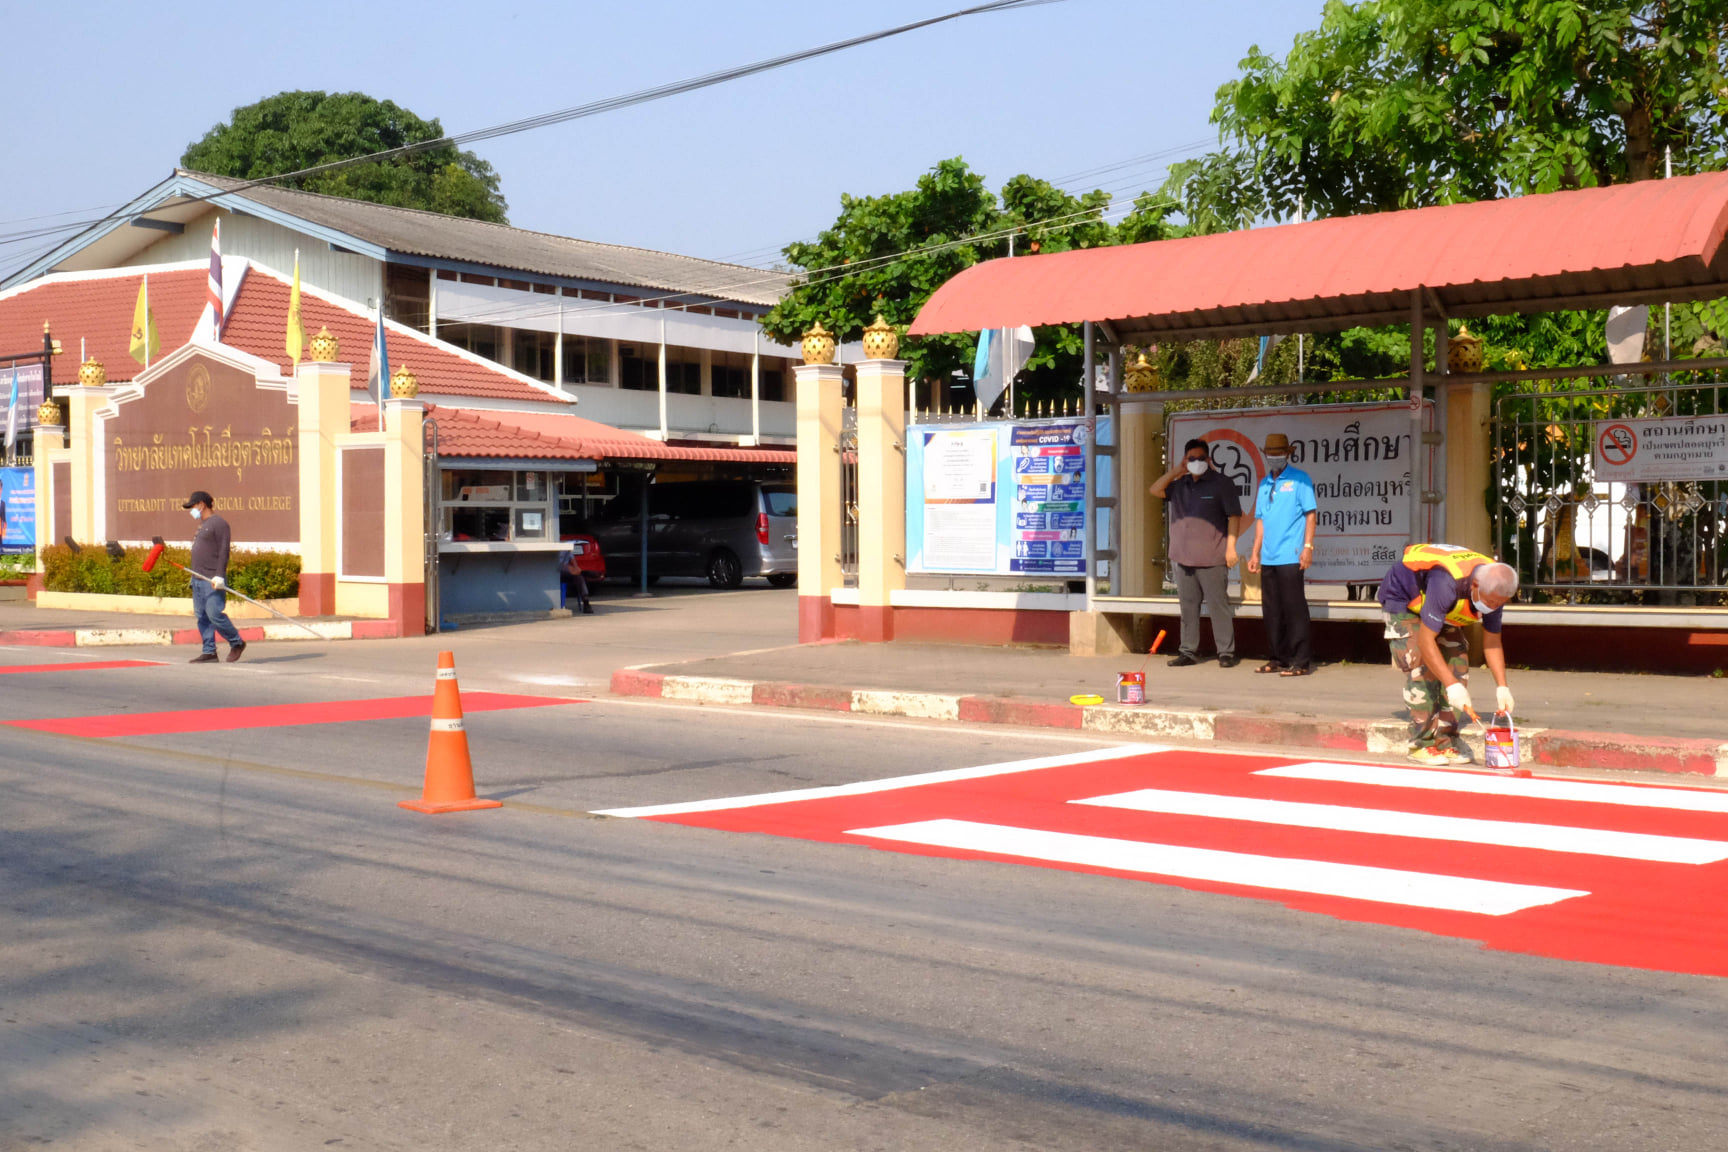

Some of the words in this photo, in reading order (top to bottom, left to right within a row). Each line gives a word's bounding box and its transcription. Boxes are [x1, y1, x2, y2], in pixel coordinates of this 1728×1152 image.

[1039, 436, 1060, 444] COVID
[117, 498, 167, 512] UTTARADIT
[248, 496, 293, 511] COLLEGE
